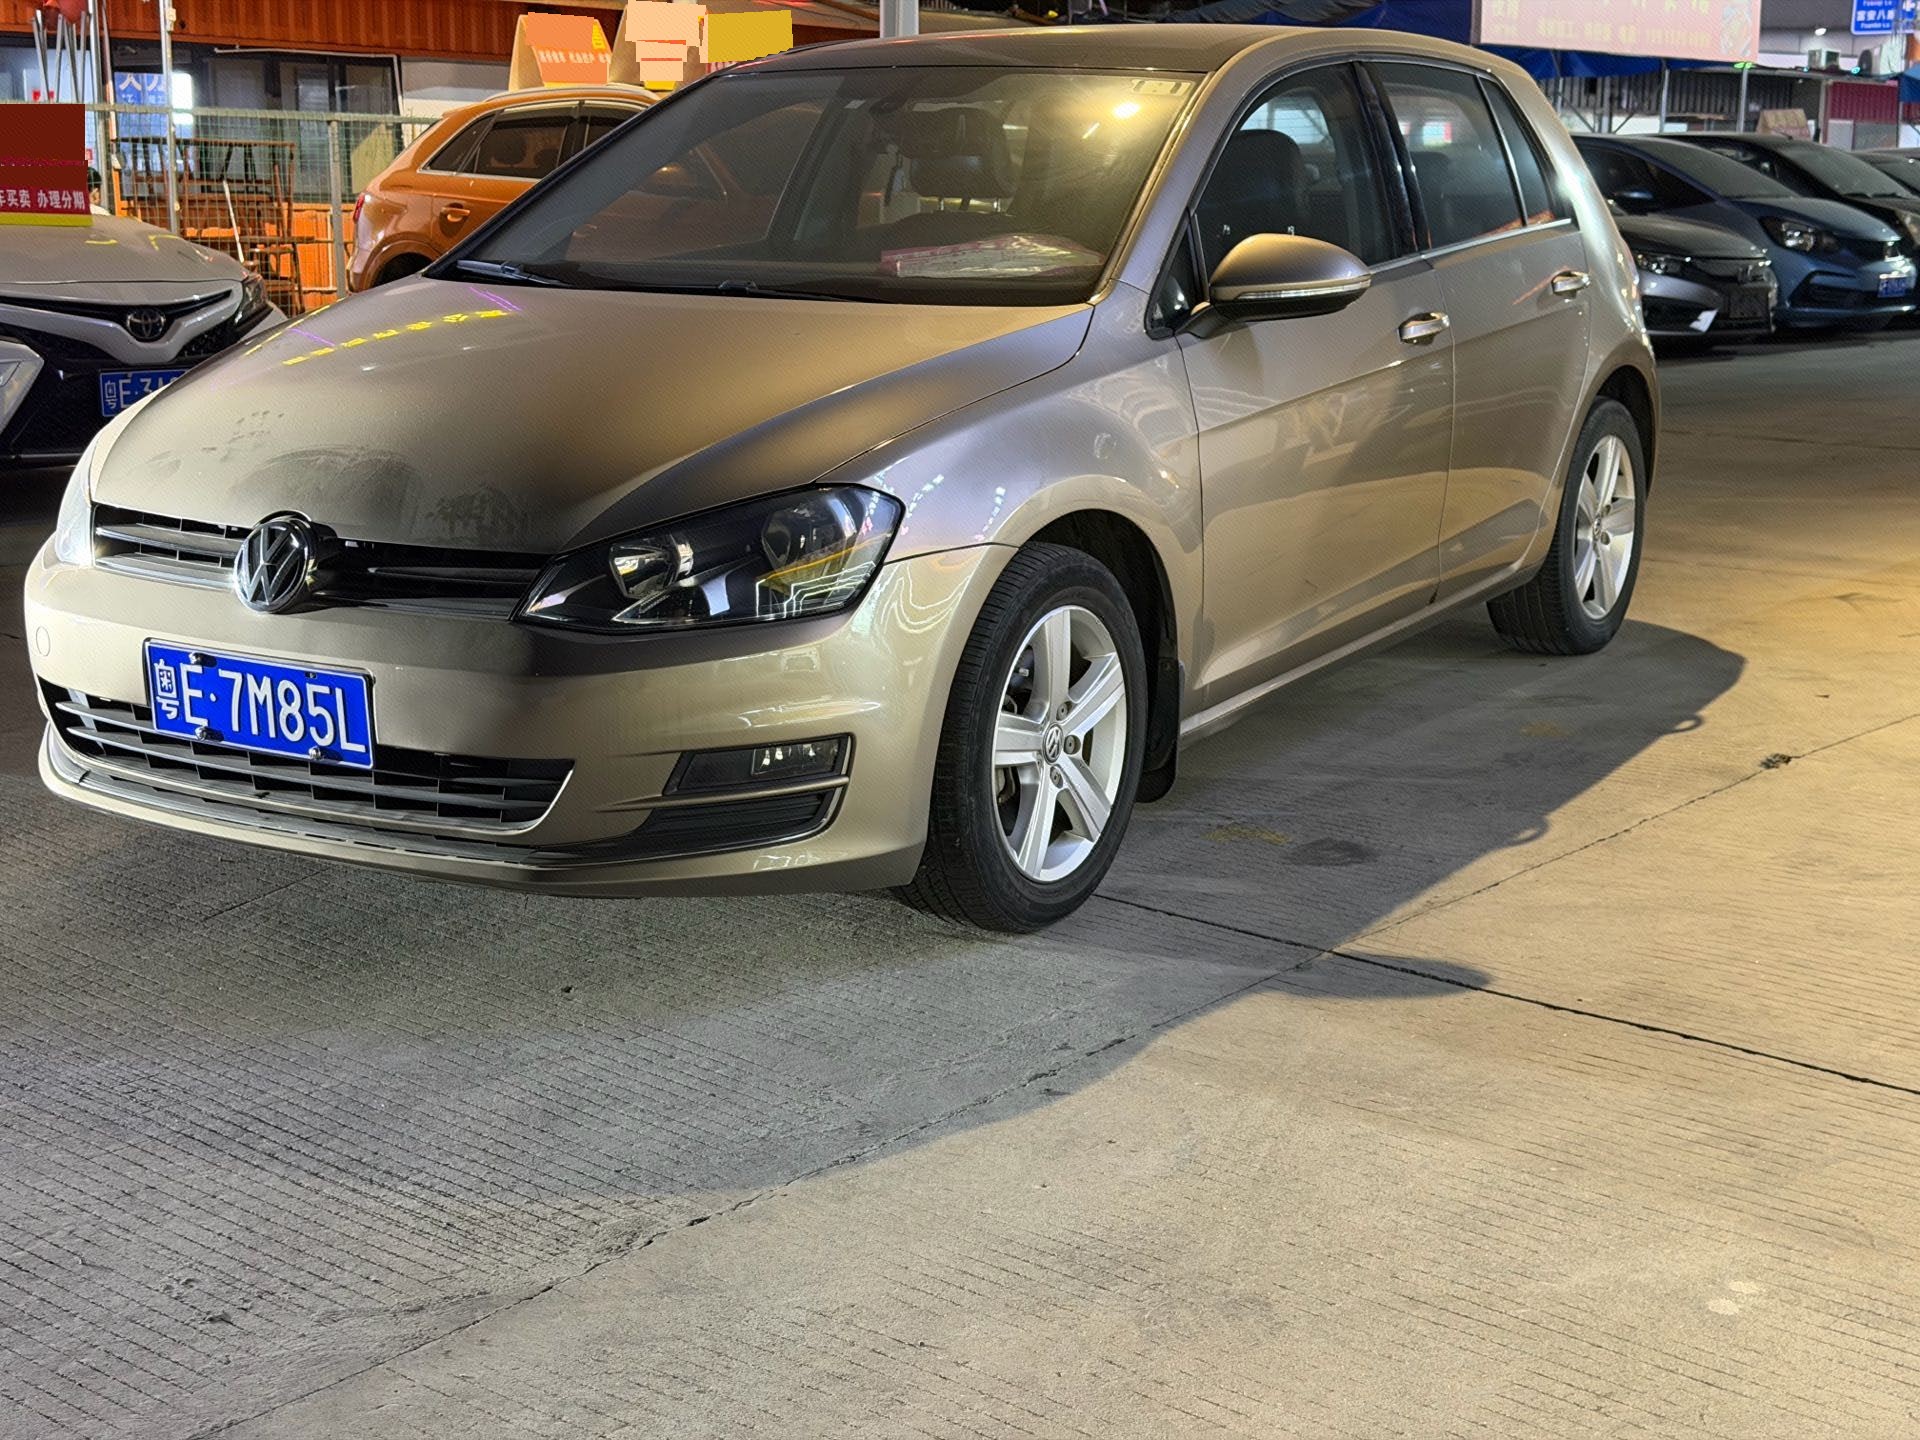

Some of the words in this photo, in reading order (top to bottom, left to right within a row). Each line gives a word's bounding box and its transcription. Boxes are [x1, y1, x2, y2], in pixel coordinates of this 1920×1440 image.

[37, 189, 86, 210] 办理分期
[104, 377, 177, 409] 粤E·3
[154, 658, 367, 753] 粤E·7M85L
